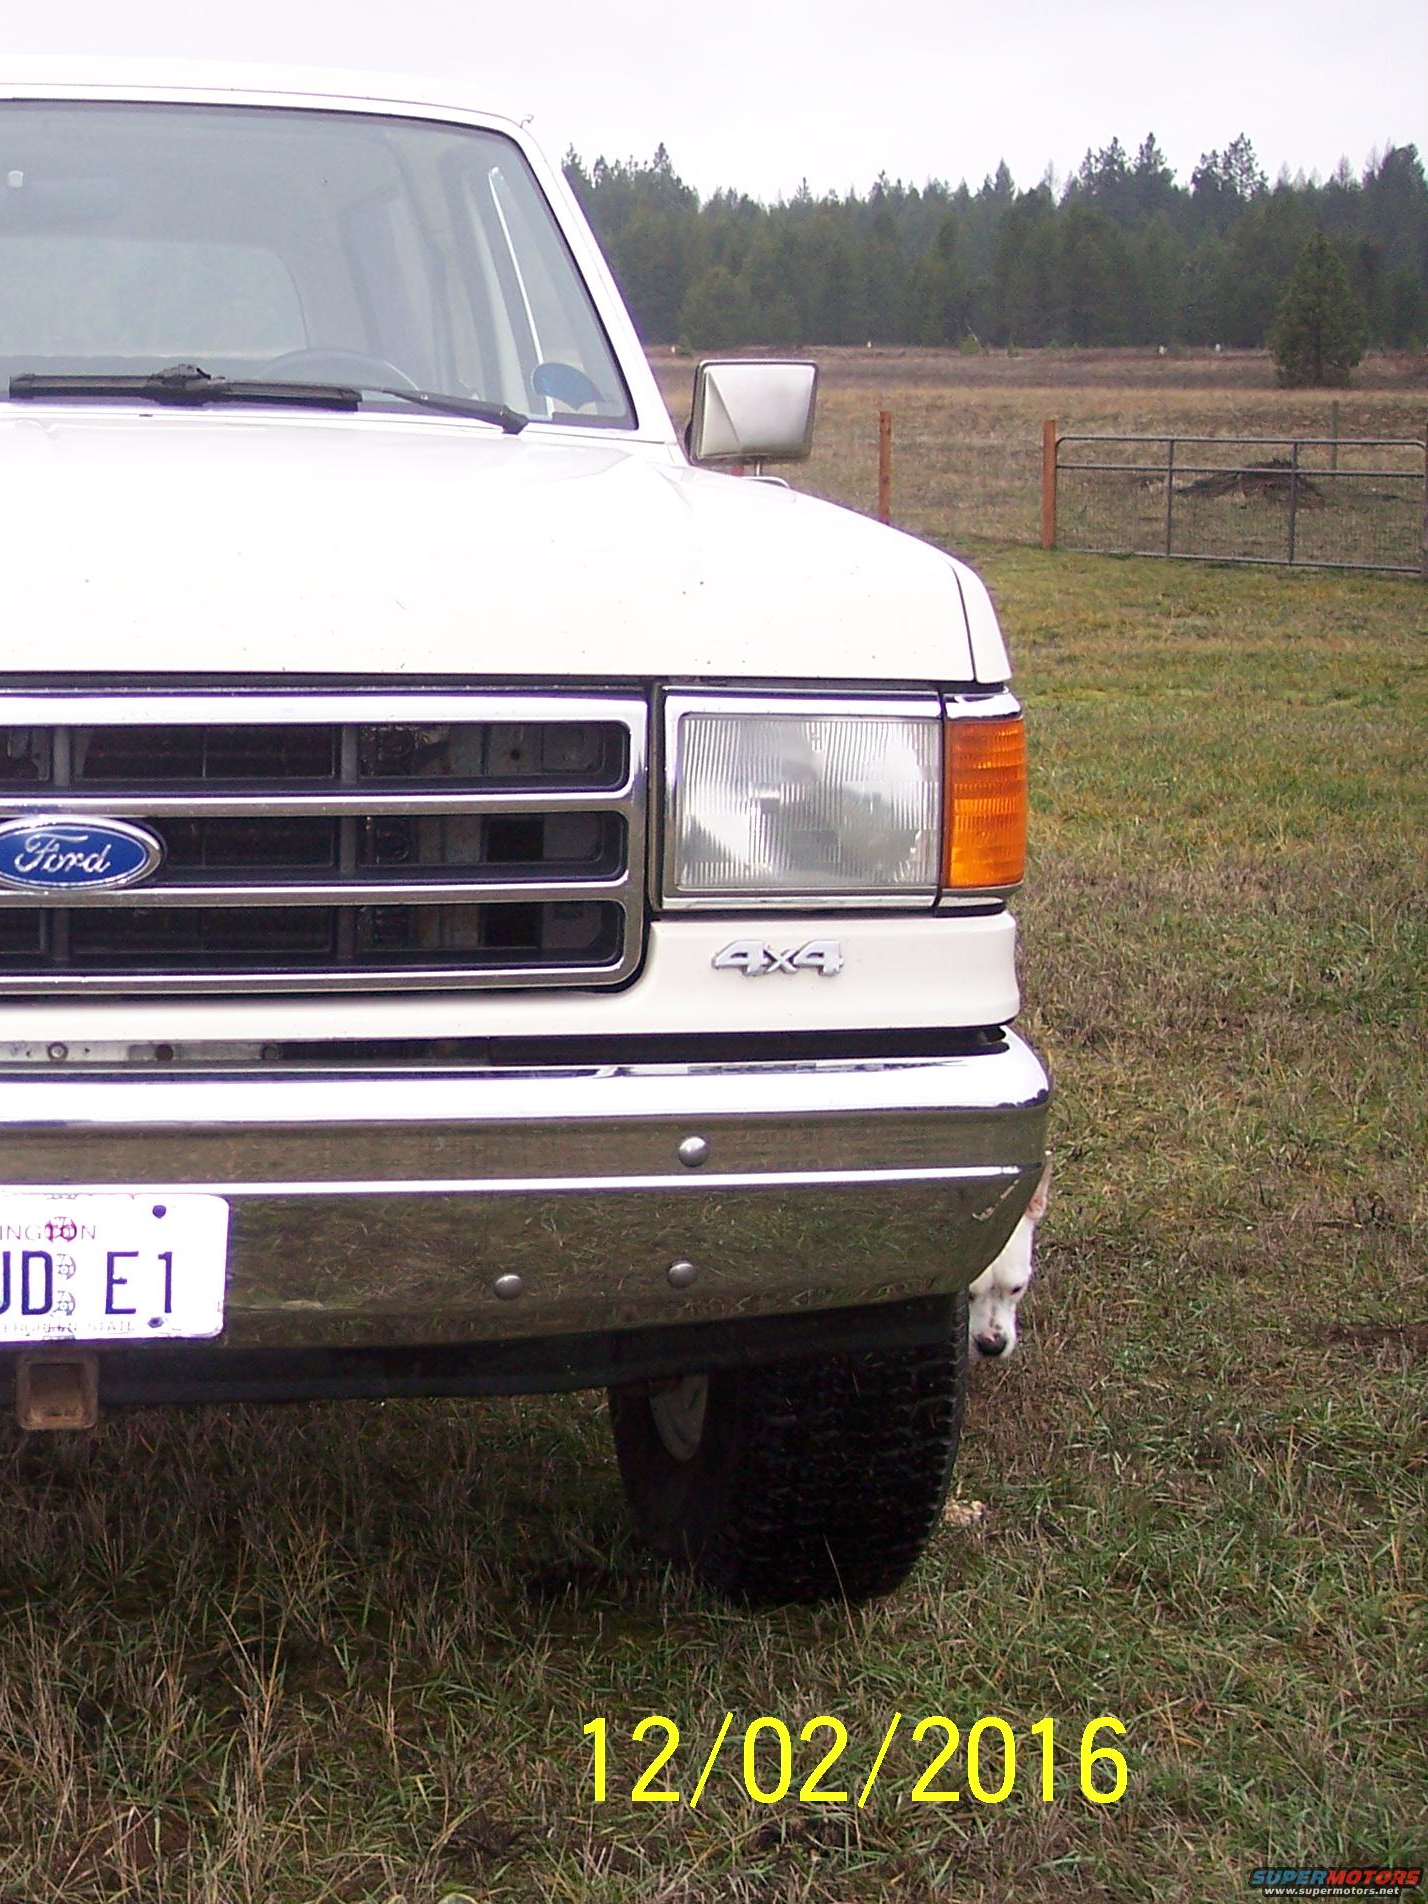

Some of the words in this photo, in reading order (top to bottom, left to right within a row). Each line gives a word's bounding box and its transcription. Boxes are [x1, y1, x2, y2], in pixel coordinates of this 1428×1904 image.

[14, 832, 112, 873] Ford
[712, 940, 844, 976] 4x4
[105, 1250, 173, 1314] E1
